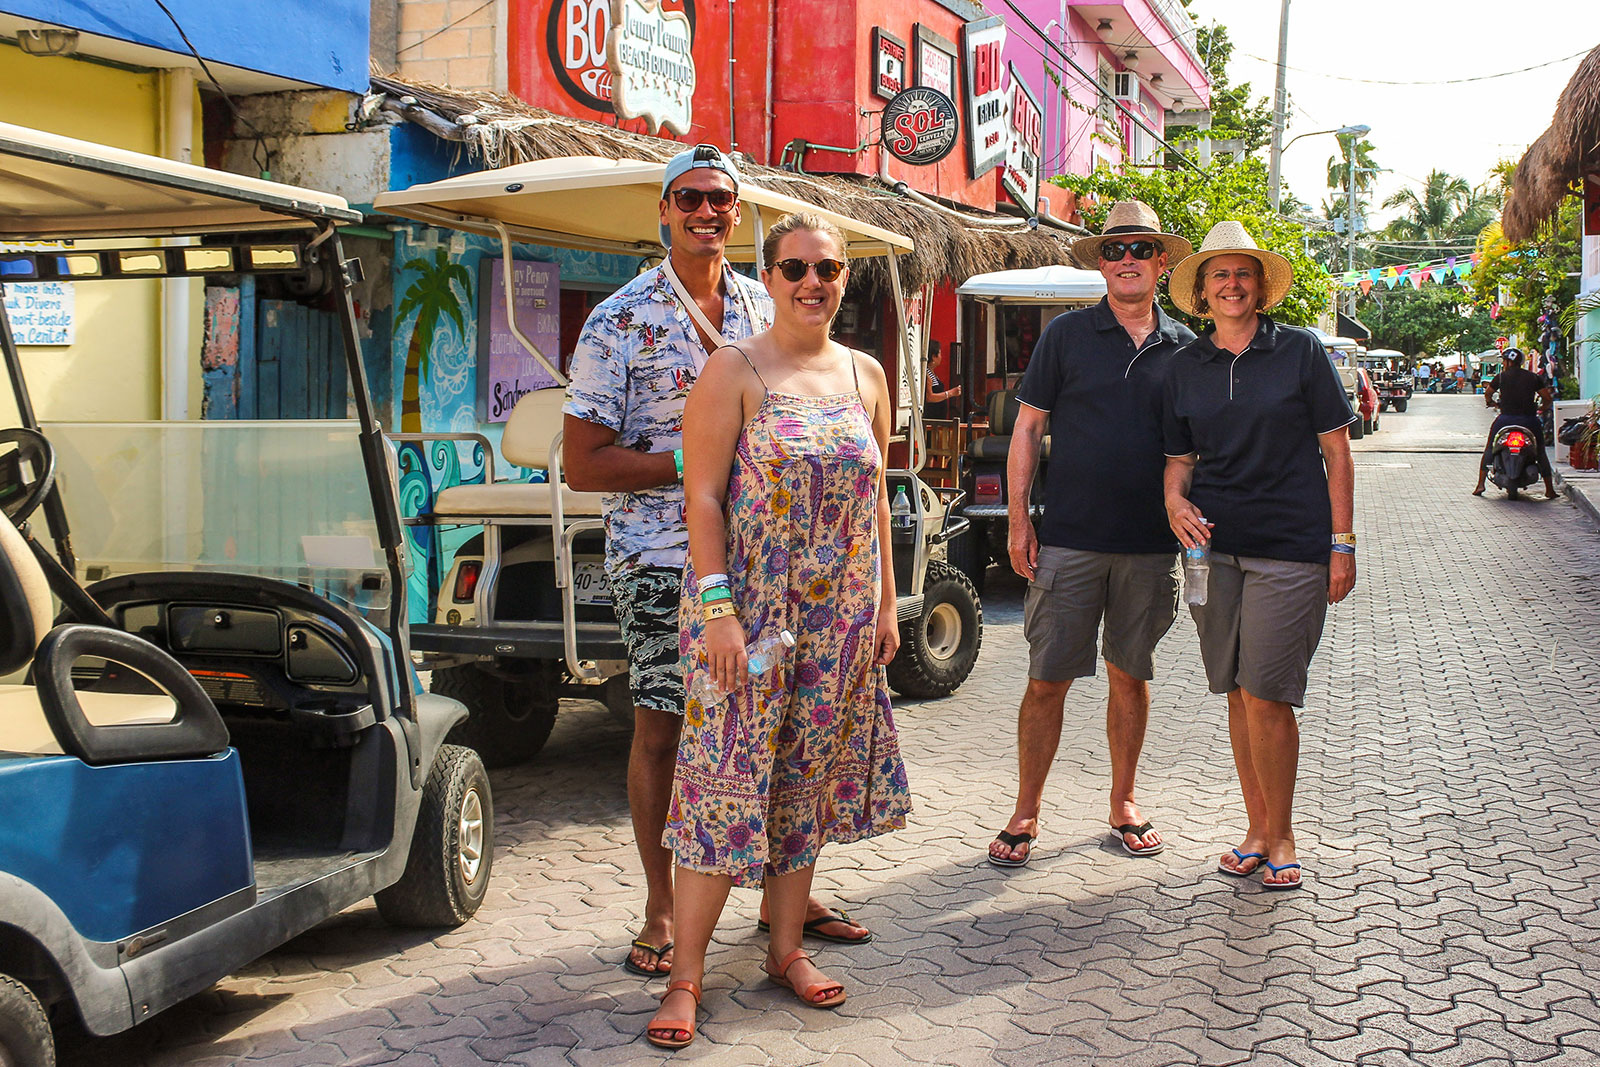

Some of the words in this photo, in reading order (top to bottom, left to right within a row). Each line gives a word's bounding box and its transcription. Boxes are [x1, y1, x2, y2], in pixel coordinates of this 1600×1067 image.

[623, 4, 655, 52] Jenny
[657, 19, 688, 63] Penny
[619, 43, 650, 72] BEACH
[651, 55, 692, 87] BOUTIQUE
[975, 40, 1000, 97] BO
[919, 131, 945, 142] CERVEZA
[526, 265, 550, 288] Penny
[14, 284, 38, 294] more
[25, 296, 61, 310] Divers
[28, 328, 67, 343] Center
[574, 573, 610, 591] 40-5
